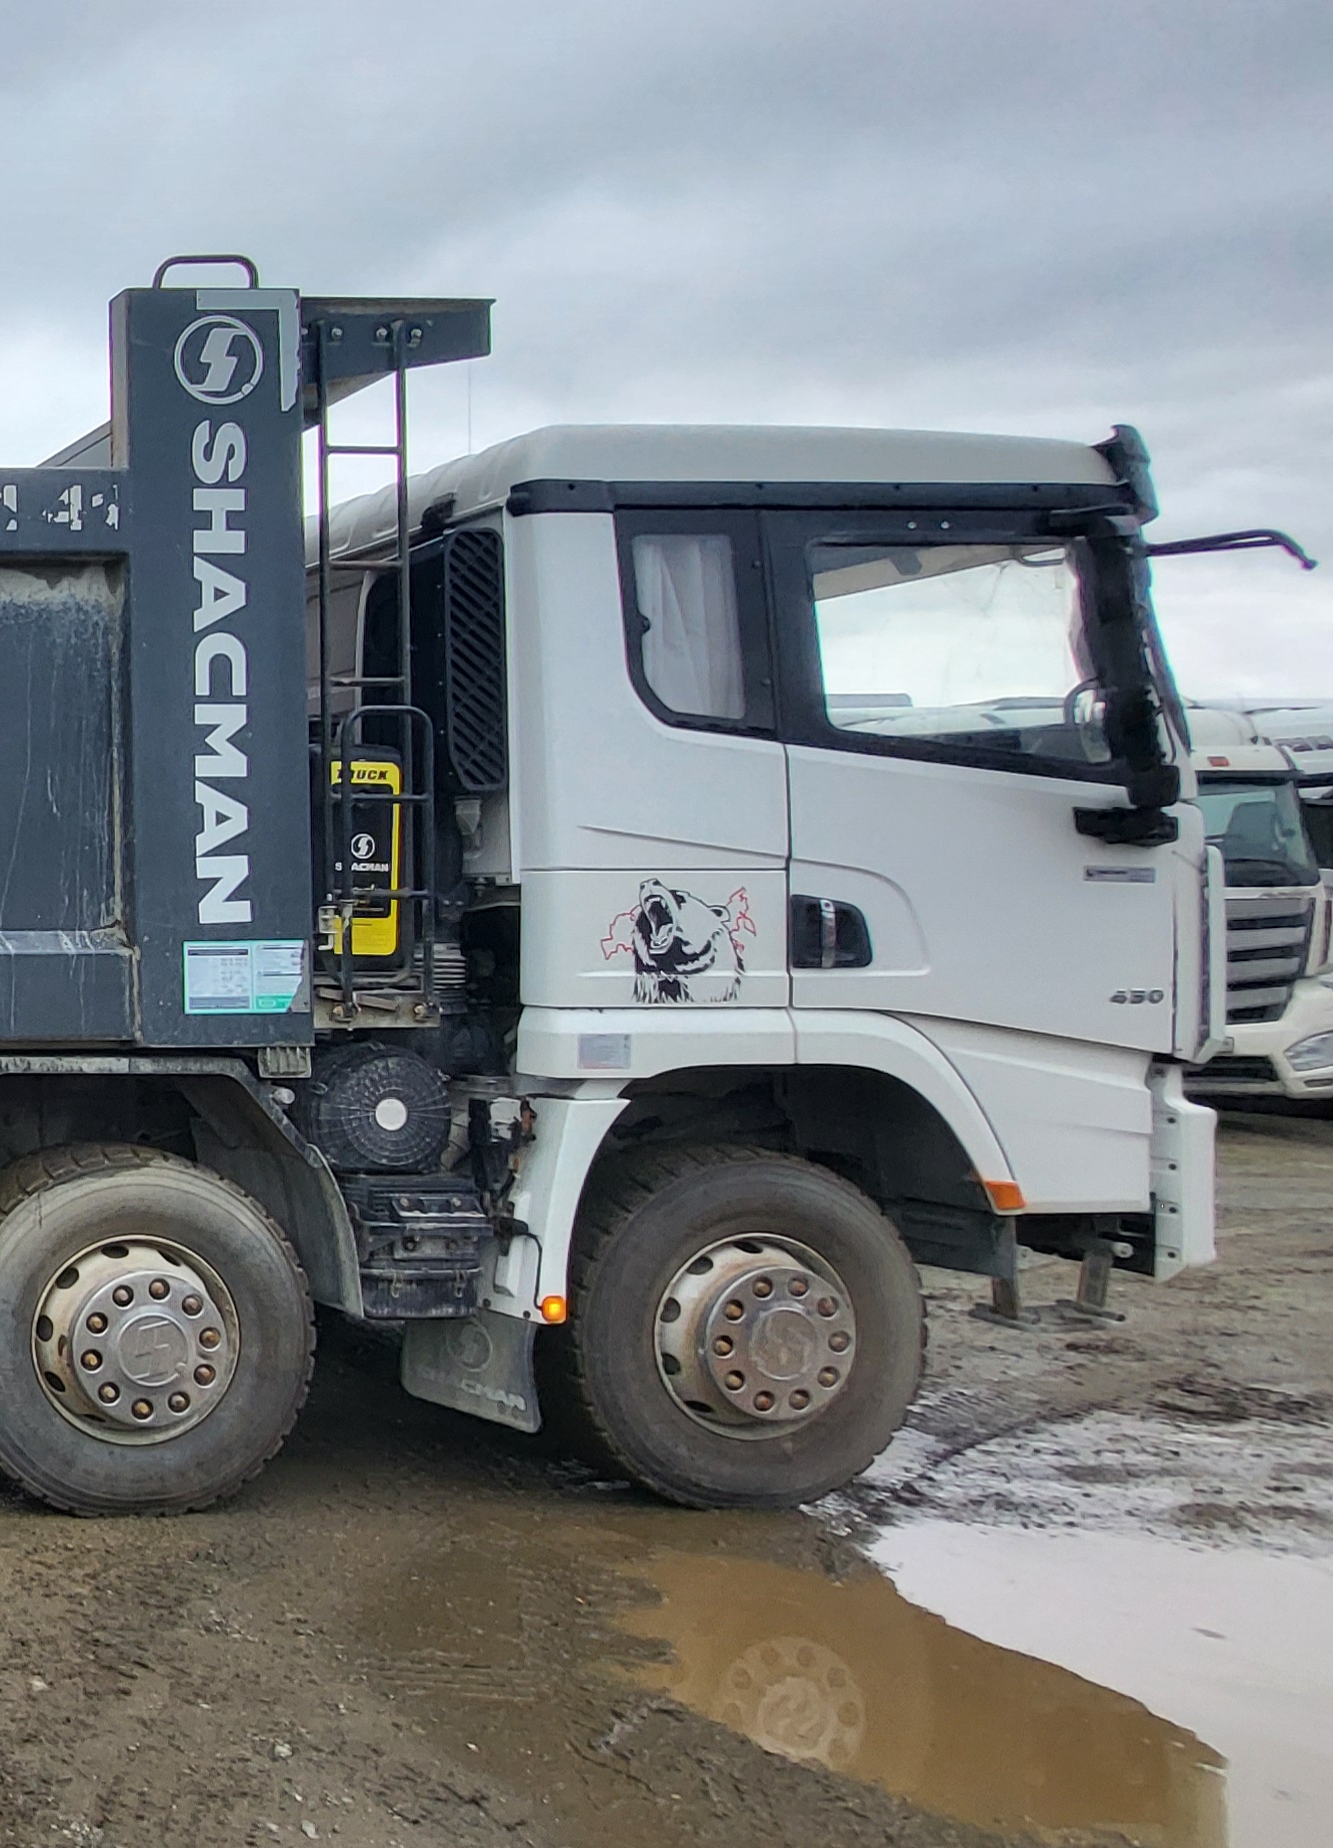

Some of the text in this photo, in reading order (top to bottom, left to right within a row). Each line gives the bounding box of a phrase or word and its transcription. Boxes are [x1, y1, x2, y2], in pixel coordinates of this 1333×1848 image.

[192, 419, 252, 924] SHACMAN
[337, 768, 389, 780] TUCK
[335, 862, 389, 872] SACMAN
